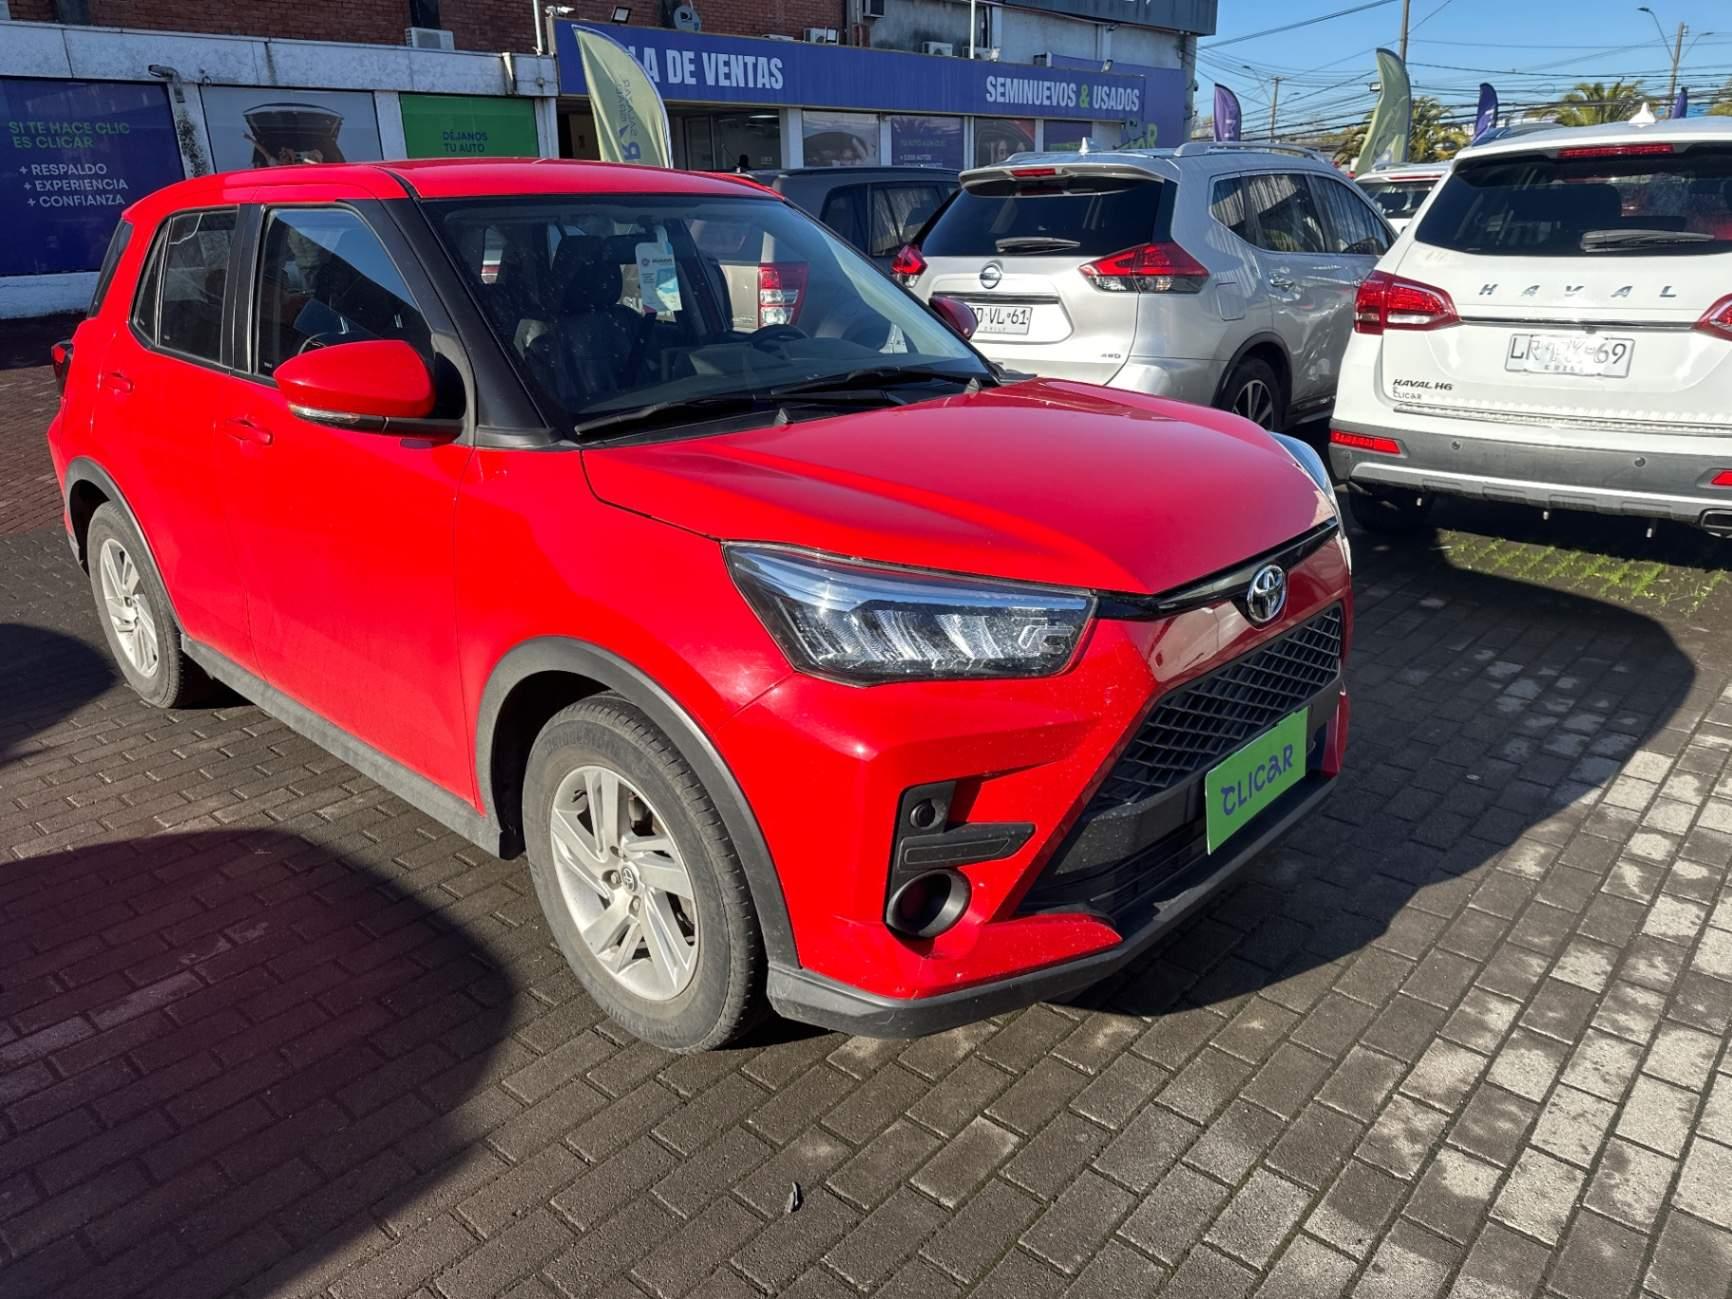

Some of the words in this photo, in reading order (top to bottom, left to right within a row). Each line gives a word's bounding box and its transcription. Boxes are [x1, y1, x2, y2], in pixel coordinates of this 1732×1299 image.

[666, 48, 697, 85] DE
[701, 52, 785, 90] VENTAS
[986, 75, 1076, 108] SEMINUEVOS
[1079, 83, 1090, 109] &
[1092, 84, 1140, 112] USADOS
[9, 121, 25, 134] SI
[27, 121, 47, 134] TE
[49, 121, 93, 134] HACE
[95, 122, 130, 135] CLIC
[13, 136, 33, 149] ES
[36, 136, 95, 149] CLICAR
[443, 143, 457, 153] TU
[459, 143, 486, 153] AUTO
[31, 163, 107, 176] RESPALDO
[35, 178, 129, 192] EXPERIENCIA
[39, 194, 126, 207] CONFIANZA
[1478, 283, 1678, 298] HAVAL
[1393, 378, 1433, 390] HAVAL
